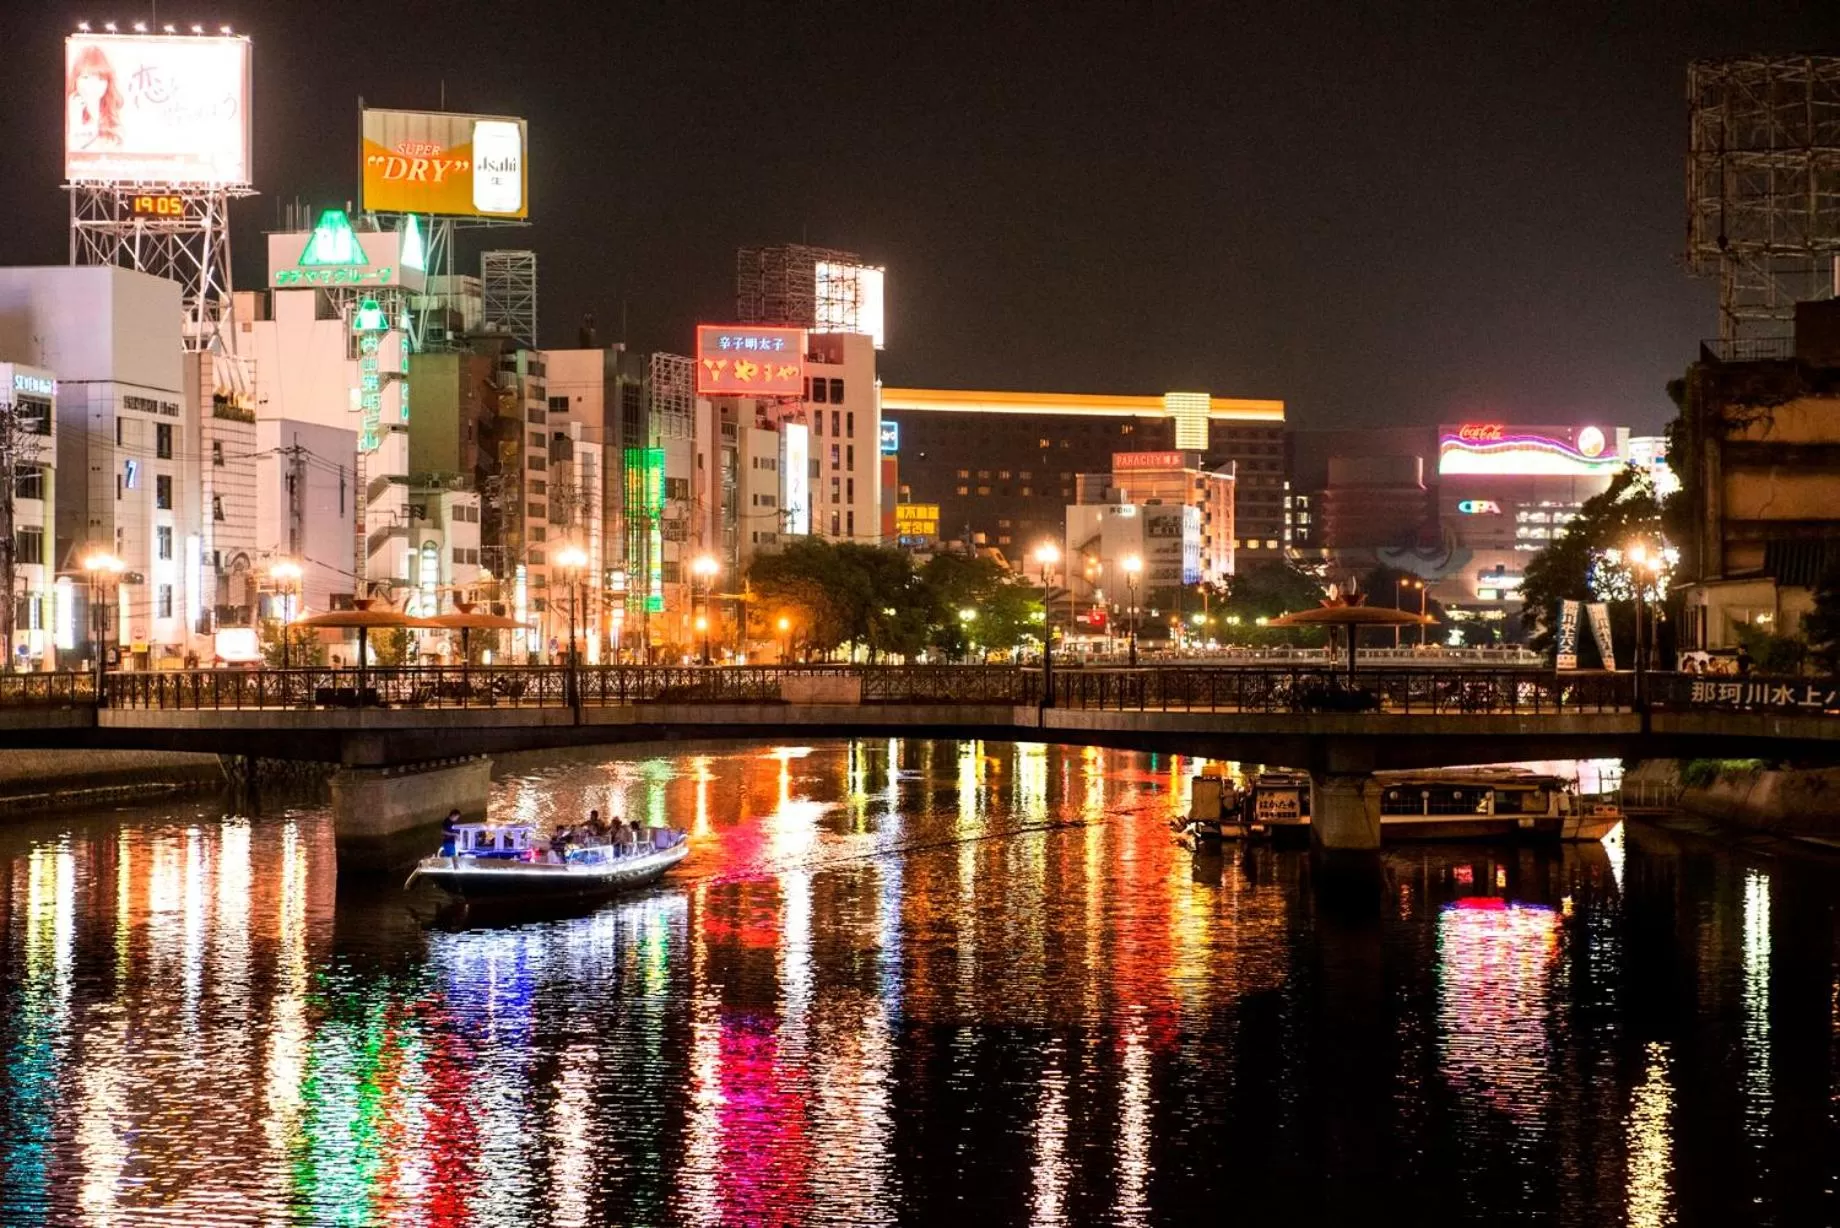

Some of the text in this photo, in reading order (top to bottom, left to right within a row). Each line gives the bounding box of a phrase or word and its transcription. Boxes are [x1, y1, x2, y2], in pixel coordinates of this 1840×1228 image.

[397, 143, 441, 156] SUPER
[477, 156, 517, 173] Asahi
[275, 267, 393, 286] ウチヤマグループ
[718, 336, 785, 351] 辛子明太子
[1459, 423, 1504, 440] Coca-Cola
[125, 459, 137, 489] 7
[1457, 500, 1501, 514] OPA
